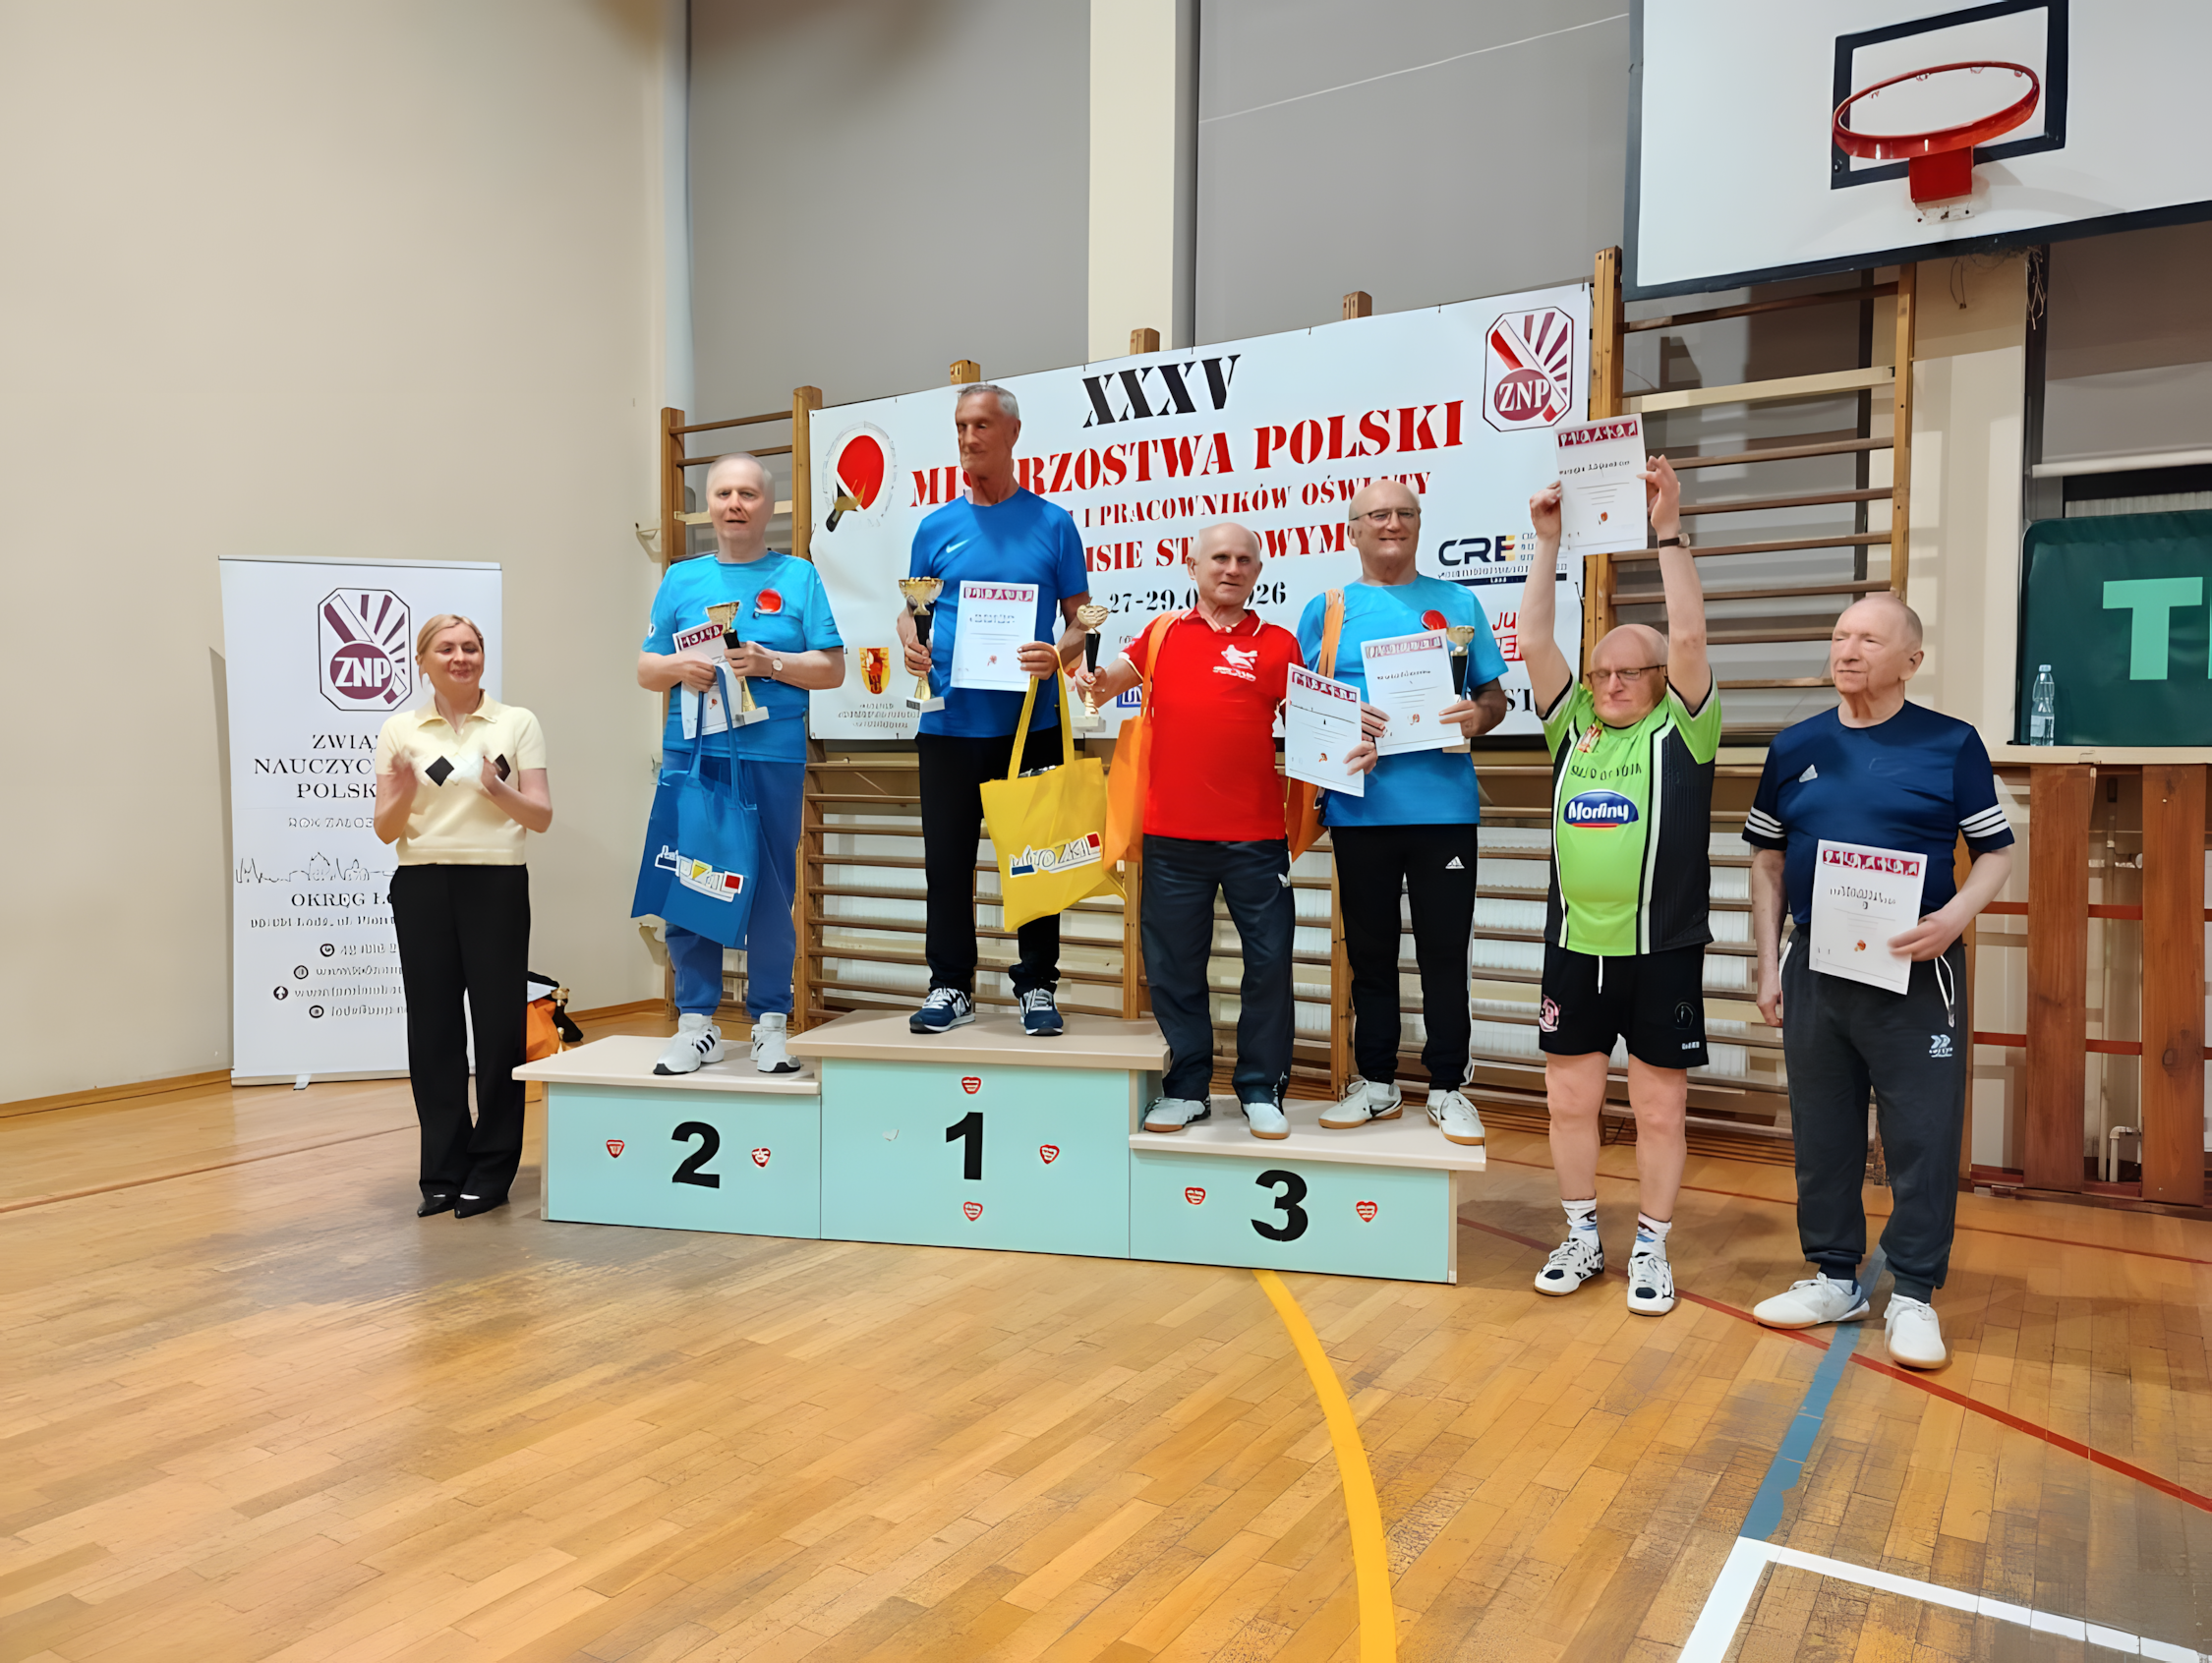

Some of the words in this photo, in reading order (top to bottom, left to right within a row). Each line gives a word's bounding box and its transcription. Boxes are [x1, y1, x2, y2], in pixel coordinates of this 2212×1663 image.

[1082, 355, 1242, 429] XXXV
[1499, 378, 1550, 412] ZNP
[909, 431, 1235, 508] MIRZOSTWA
[1253, 400, 1465, 471] POLSKI
[1100, 484, 1292, 527] PRACOWNIKÓW
[1438, 535, 1515, 567] CRE
[2103, 576, 2212, 681] T
[334, 657, 391, 688] ZNP
[254, 758, 376, 774] NAUCZYC
[670, 1120, 721, 1188] 2
[946, 1112, 983, 1180] 1
[1251, 1170, 1309, 1242] 3
